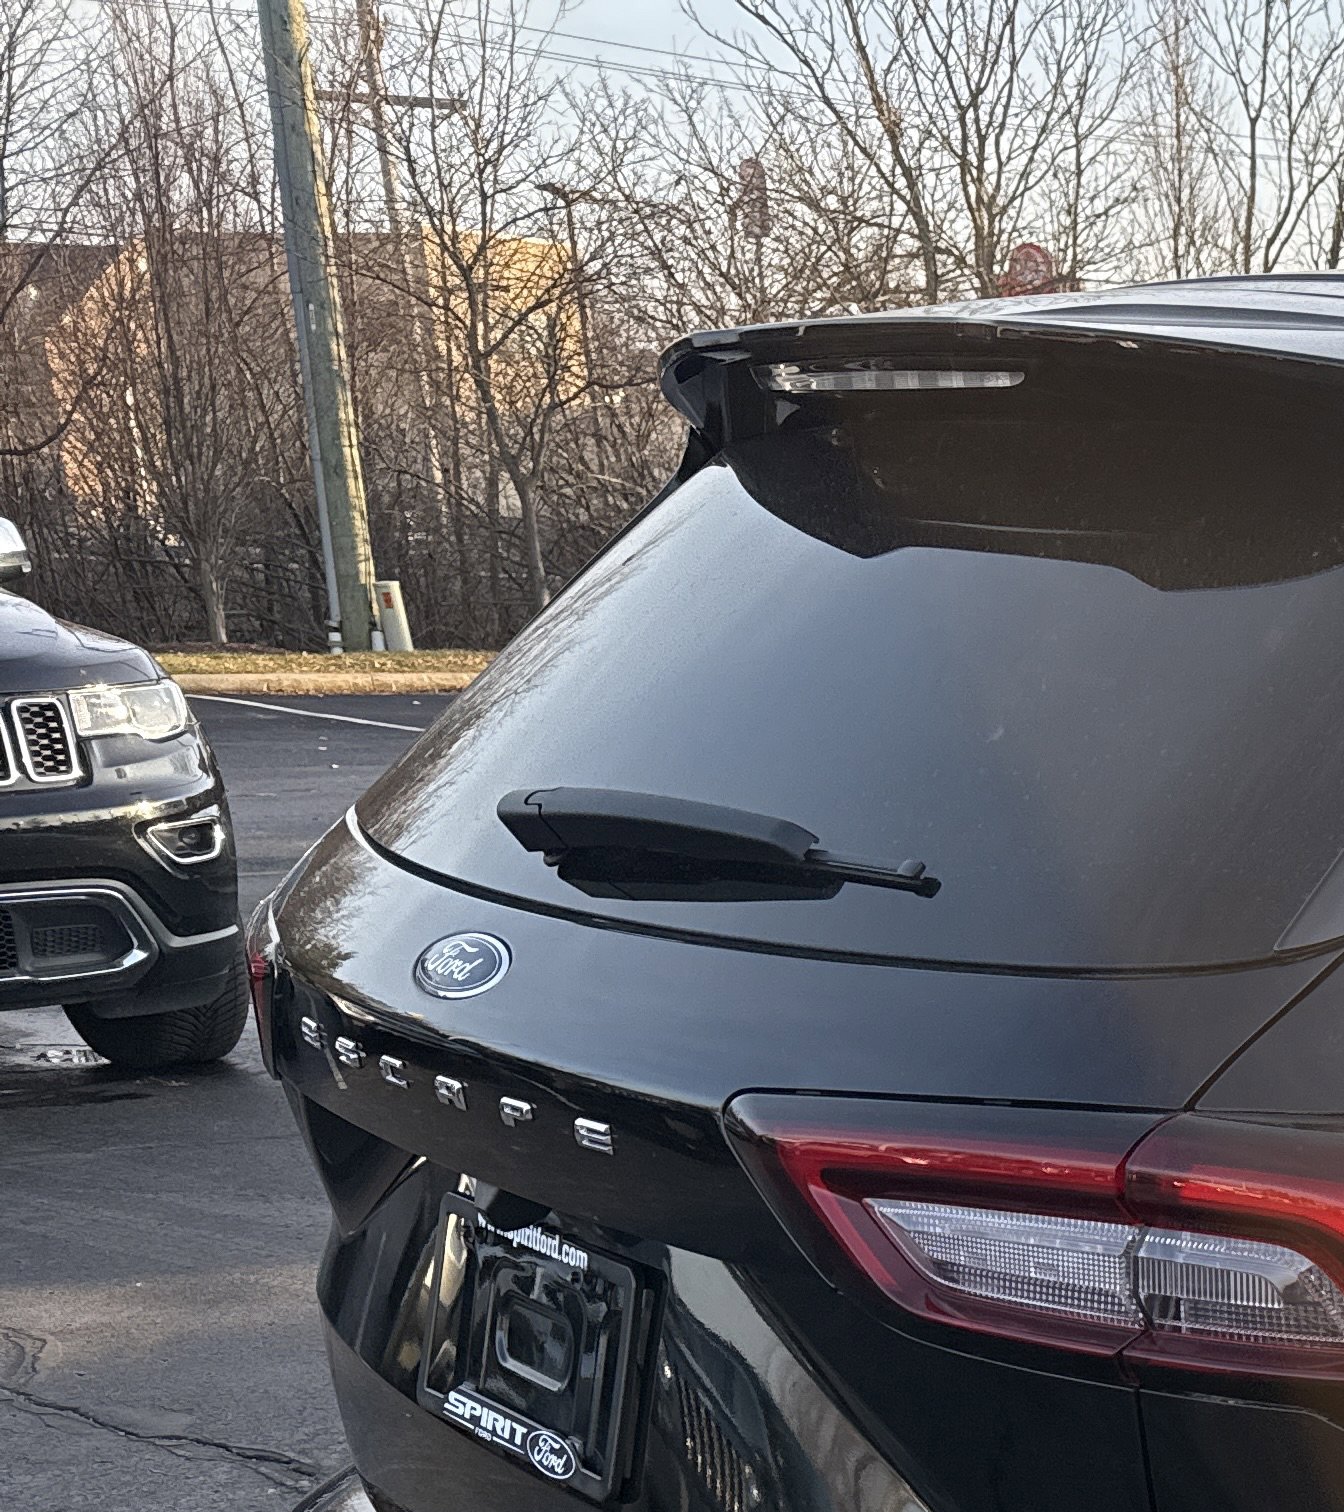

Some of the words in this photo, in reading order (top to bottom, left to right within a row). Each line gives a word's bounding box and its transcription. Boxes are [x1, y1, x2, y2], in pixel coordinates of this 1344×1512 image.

[424, 940, 484, 981] Ford
[301, 1016, 614, 1156] ESCAPE
[444, 1390, 528, 1446] SPIRIT
[533, 1434, 568, 1474] Ford
